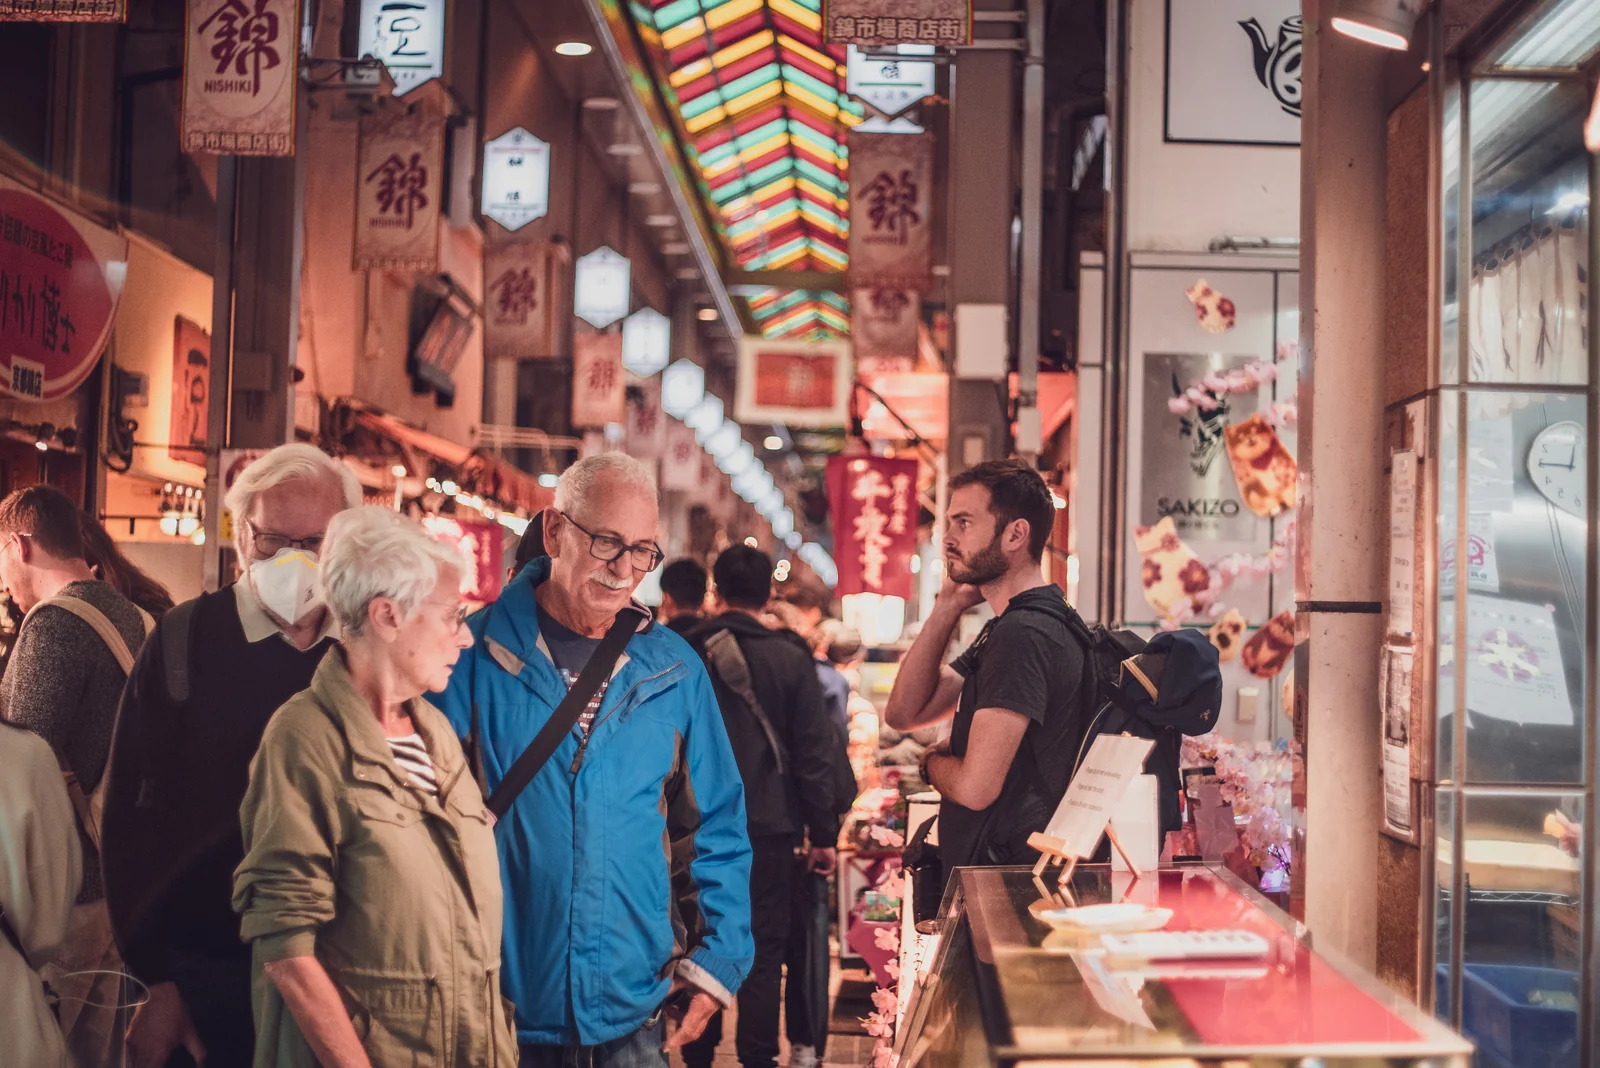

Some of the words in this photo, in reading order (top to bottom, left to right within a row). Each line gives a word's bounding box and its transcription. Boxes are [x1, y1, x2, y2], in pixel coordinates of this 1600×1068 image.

[834, 16, 960, 40] 錦市場商店街
[204, 80, 251, 93] NISHIKI
[1157, 497, 1240, 517] SAKIZO
